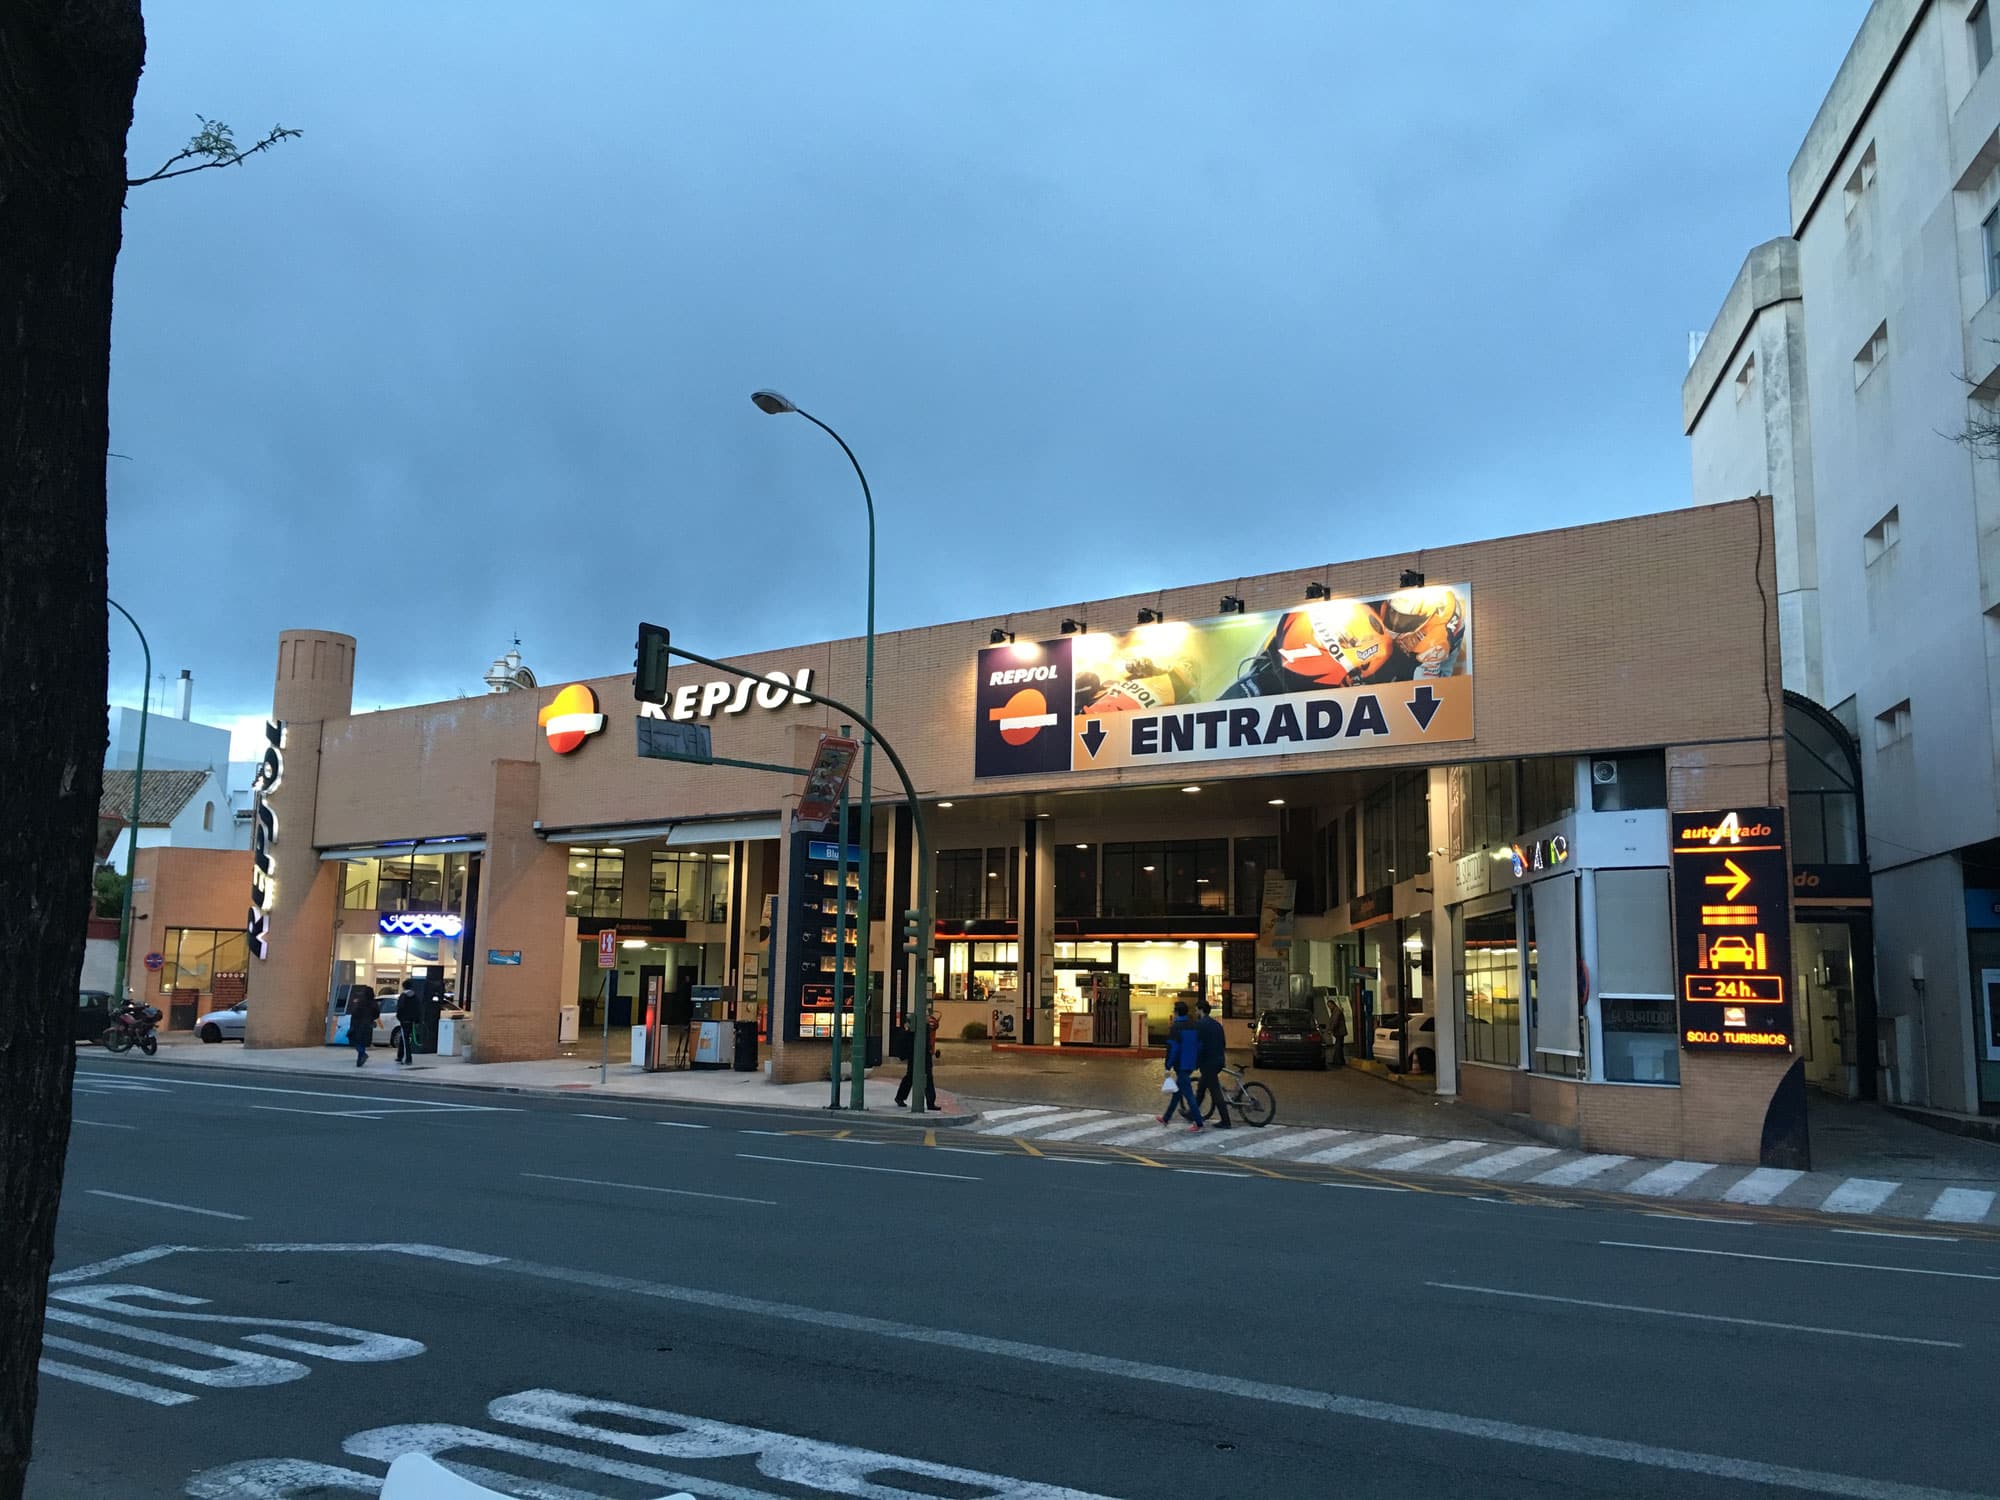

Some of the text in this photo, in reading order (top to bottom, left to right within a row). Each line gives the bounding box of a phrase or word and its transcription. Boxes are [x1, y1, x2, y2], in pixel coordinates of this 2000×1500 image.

[989, 664, 1058, 687] REPSOL
[1131, 694, 1389, 756] ENTRADA
[248, 720, 287, 960] REPSOL
[1686, 1031, 1787, 1046] SOLO TURISMOS
